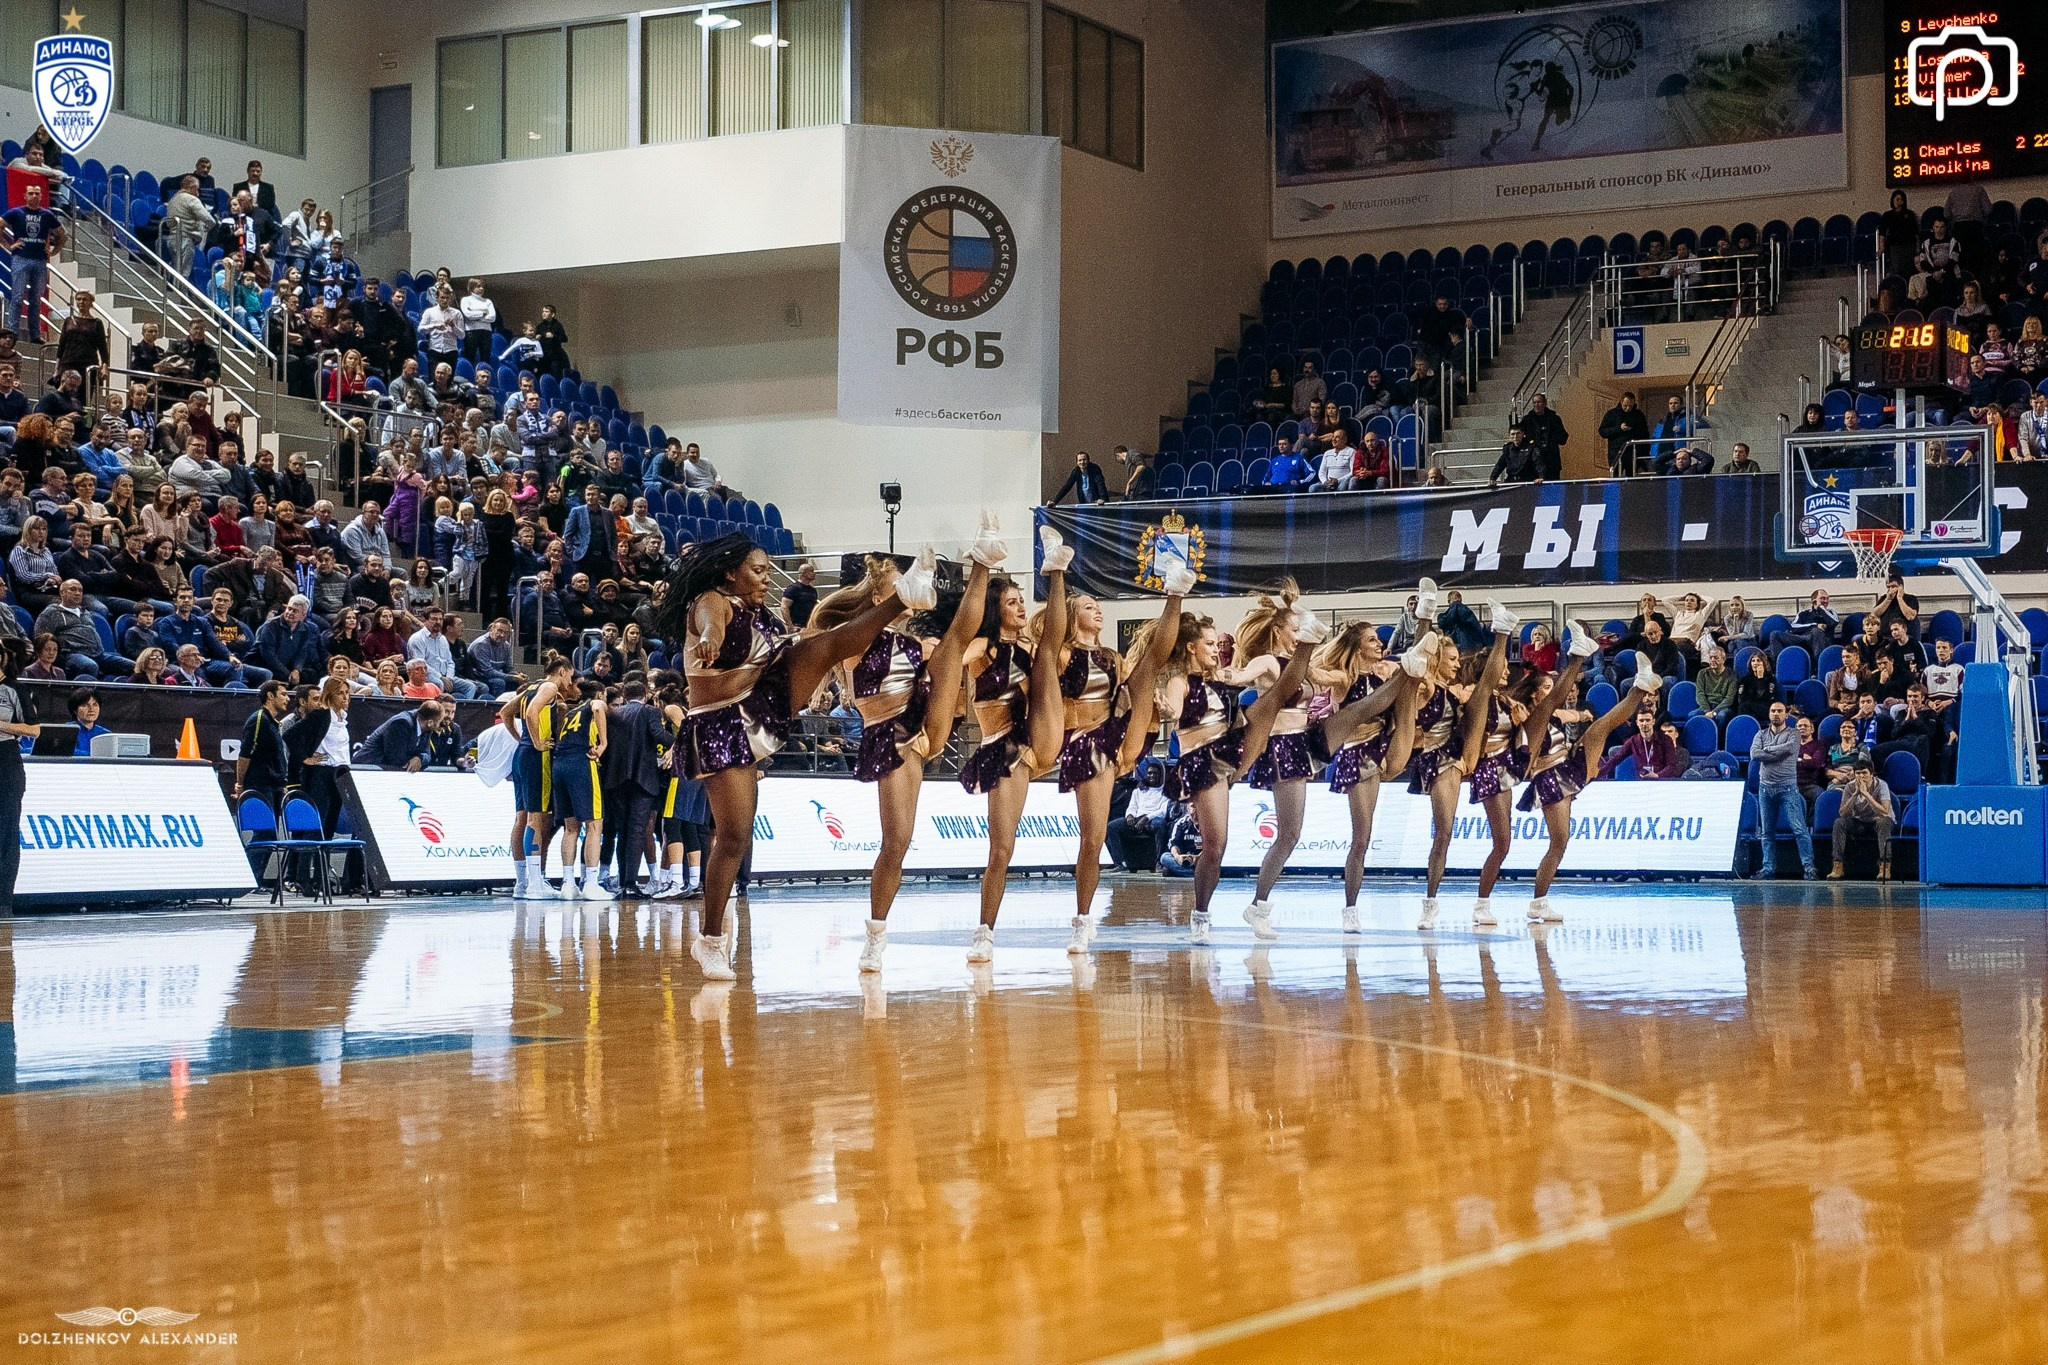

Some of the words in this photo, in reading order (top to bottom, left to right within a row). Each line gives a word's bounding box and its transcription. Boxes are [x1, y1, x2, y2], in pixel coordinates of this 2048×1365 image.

[1901, 20, 1911, 33] 9
[1918, 70, 1972, 86] Vimer
[1894, 93, 1911, 106] 13
[1918, 86, 1999, 102] Kiilloa
[1893, 147, 1910, 160] 31
[1919, 142, 1981, 158] Charles
[2016, 136, 2025, 149] 2
[1495, 176, 1597, 198] Генеральный
[1599, 172, 1663, 190] спонсор
[1666, 168, 1688, 182] БК
[1691, 163, 1772, 182] «Динамо»
[1893, 165, 1911, 178] 33
[890, 217, 929, 306] РОССИЙСКАЯ
[911, 193, 994, 220] ФЕДЕРАЦИЯ
[972, 224, 1010, 307] БАСКЕТБОЛА
[935, 303, 967, 313] 1991
[896, 328, 1004, 369] РФБ
[1617, 339, 1641, 370] D
[895, 407, 1002, 421] #здесьбаскетбол
[560, 711, 581, 741] 24
[1945, 806, 2023, 826] molten
